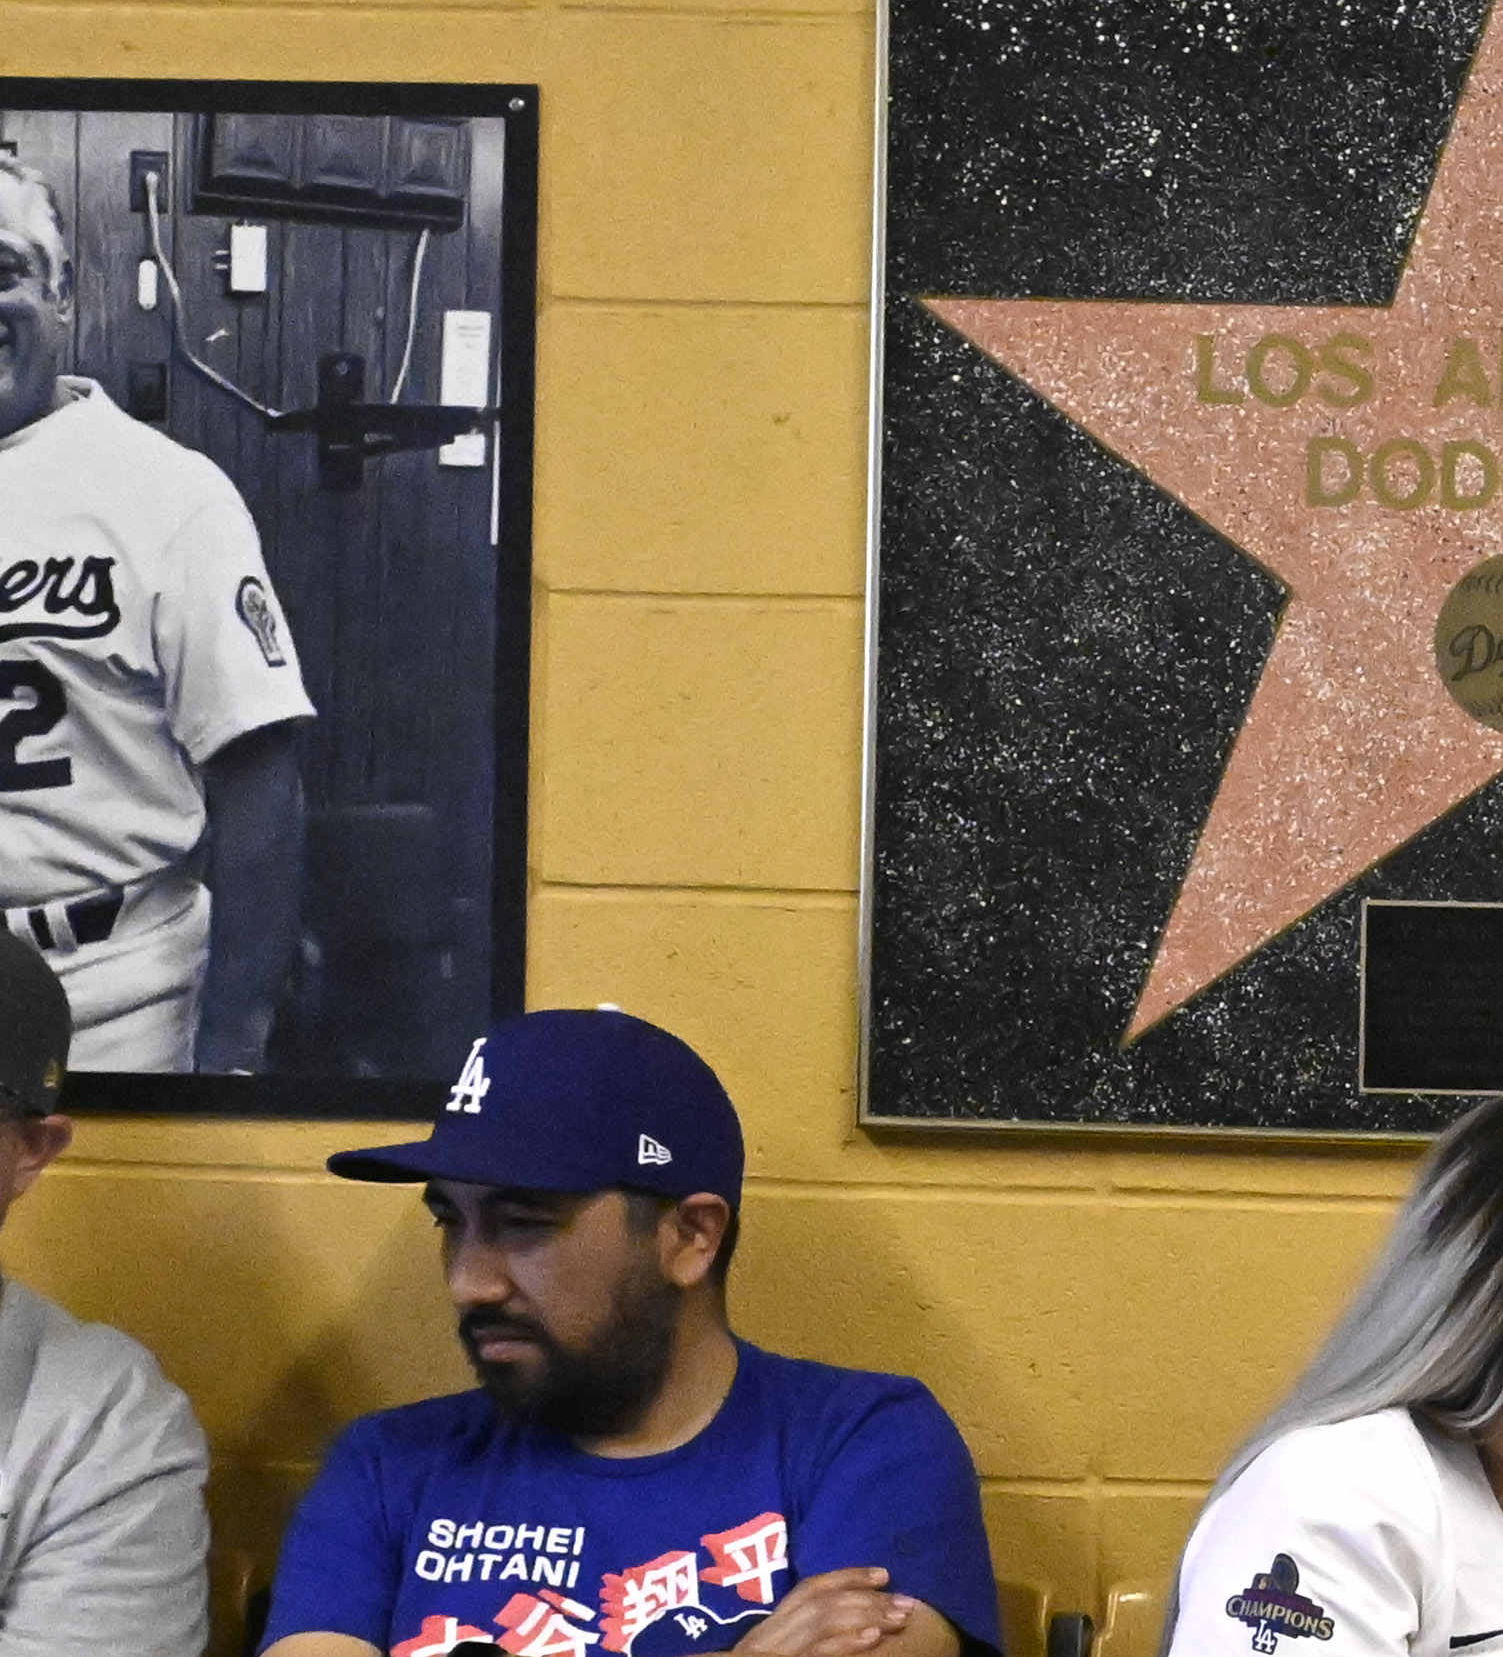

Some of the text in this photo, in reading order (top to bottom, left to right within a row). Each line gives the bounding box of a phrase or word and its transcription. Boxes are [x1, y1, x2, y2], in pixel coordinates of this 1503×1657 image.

[1195, 332, 1375, 408] LOS
[446, 1036, 492, 1114] LA
[427, 1517, 586, 1555] SHOHEI
[414, 1549, 581, 1589] OHTANI
[673, 1613, 709, 1641] LA
[1226, 1595, 1335, 1641] CHAMPIONS
[1253, 1618, 1278, 1655] LA
